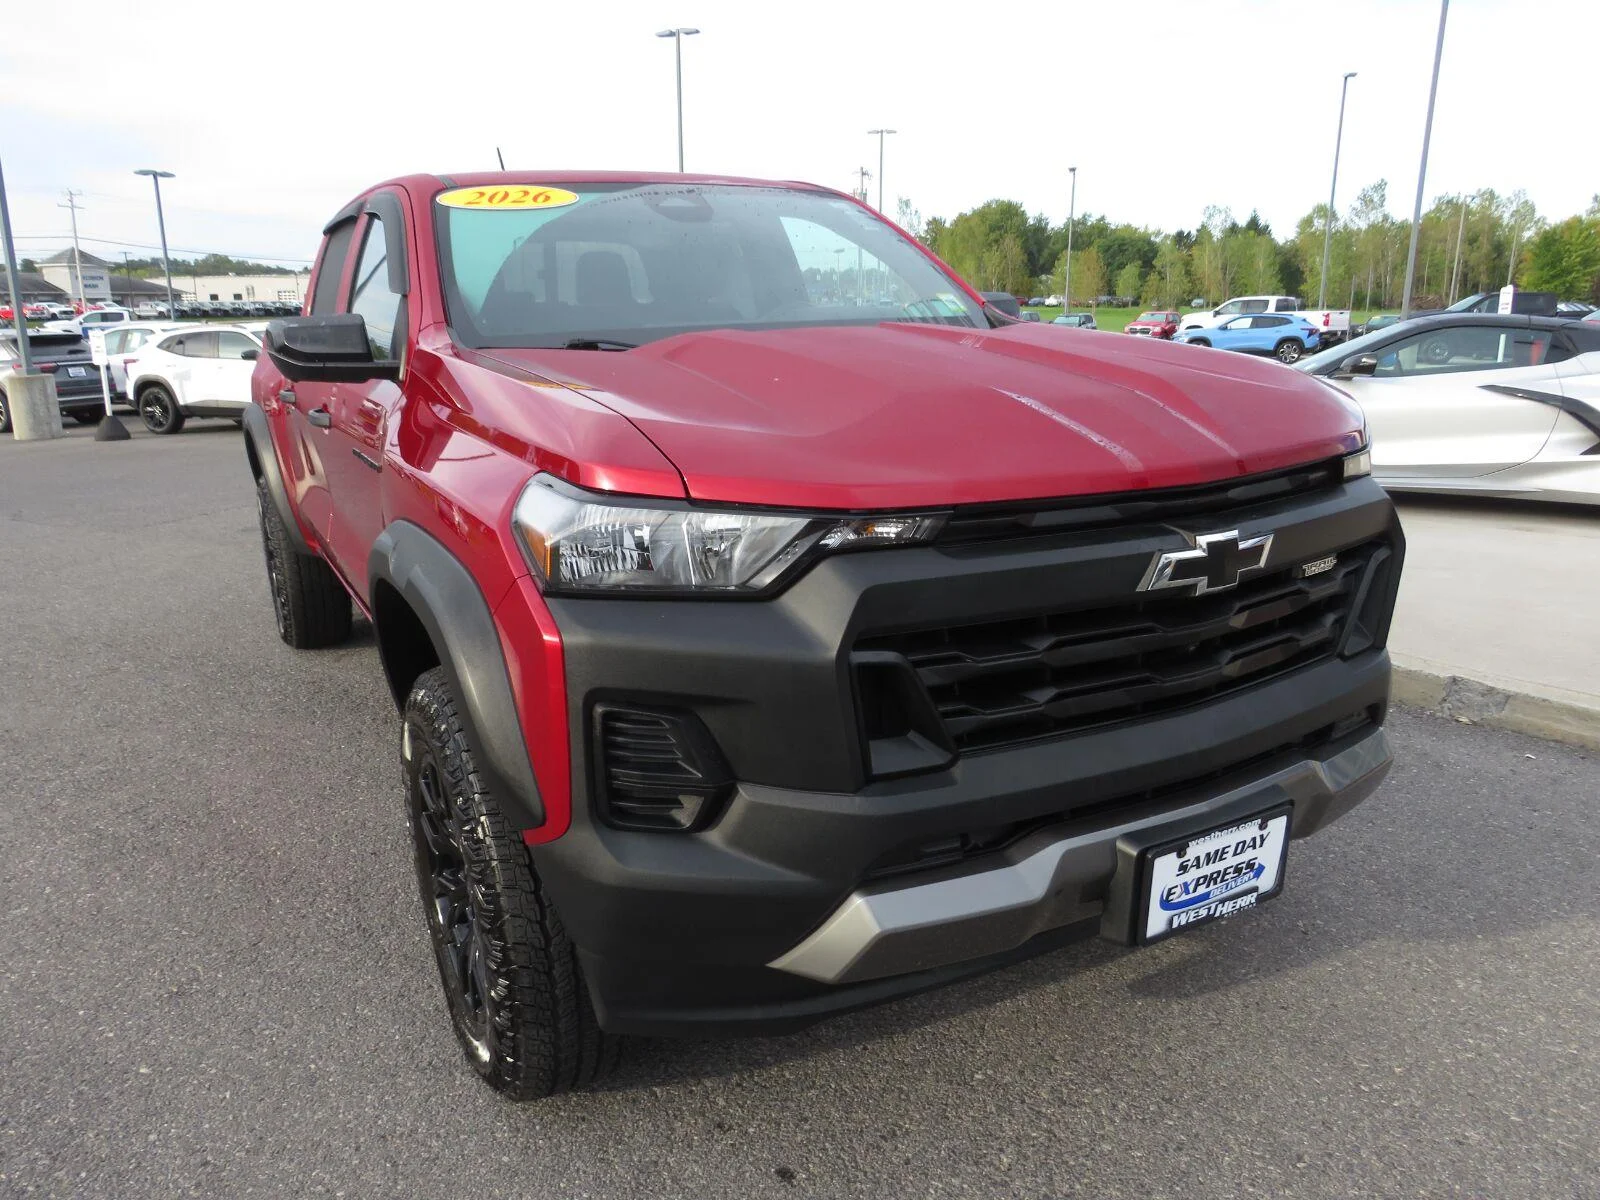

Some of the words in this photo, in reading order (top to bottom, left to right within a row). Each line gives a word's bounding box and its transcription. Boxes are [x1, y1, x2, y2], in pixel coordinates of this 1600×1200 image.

[464, 190, 551, 205] 2026
[1176, 844, 1232, 877] SAME
[1231, 831, 1271, 858] DAY
[1165, 857, 1258, 903] EXPRESS
[1209, 870, 1256, 899] DELIVERY
